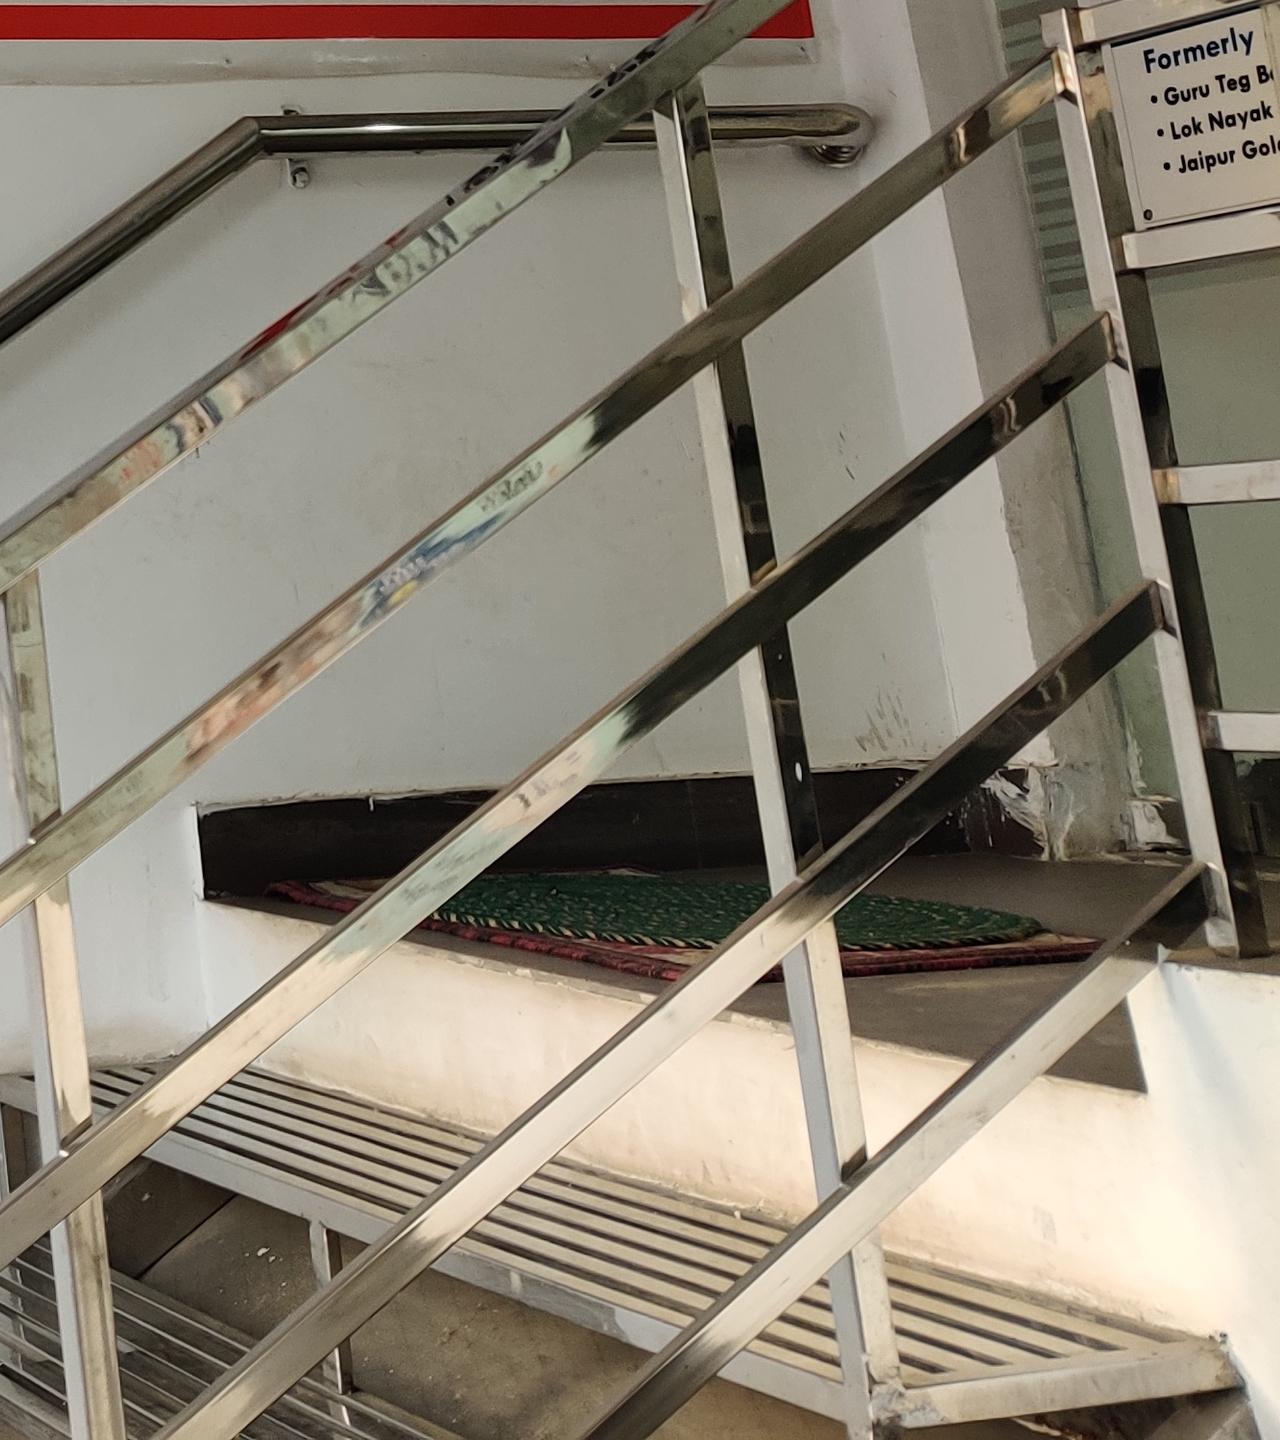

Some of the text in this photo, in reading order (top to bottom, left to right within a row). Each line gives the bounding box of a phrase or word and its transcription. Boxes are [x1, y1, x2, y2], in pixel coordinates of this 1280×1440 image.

[1143, 27, 1254, 73] Formerly
[1164, 83, 1210, 105] Guru
[1215, 74, 1251, 93] Teg
[1170, 101, 1274, 140] Lok Nayak
[1178, 149, 1236, 173] Jaipur
